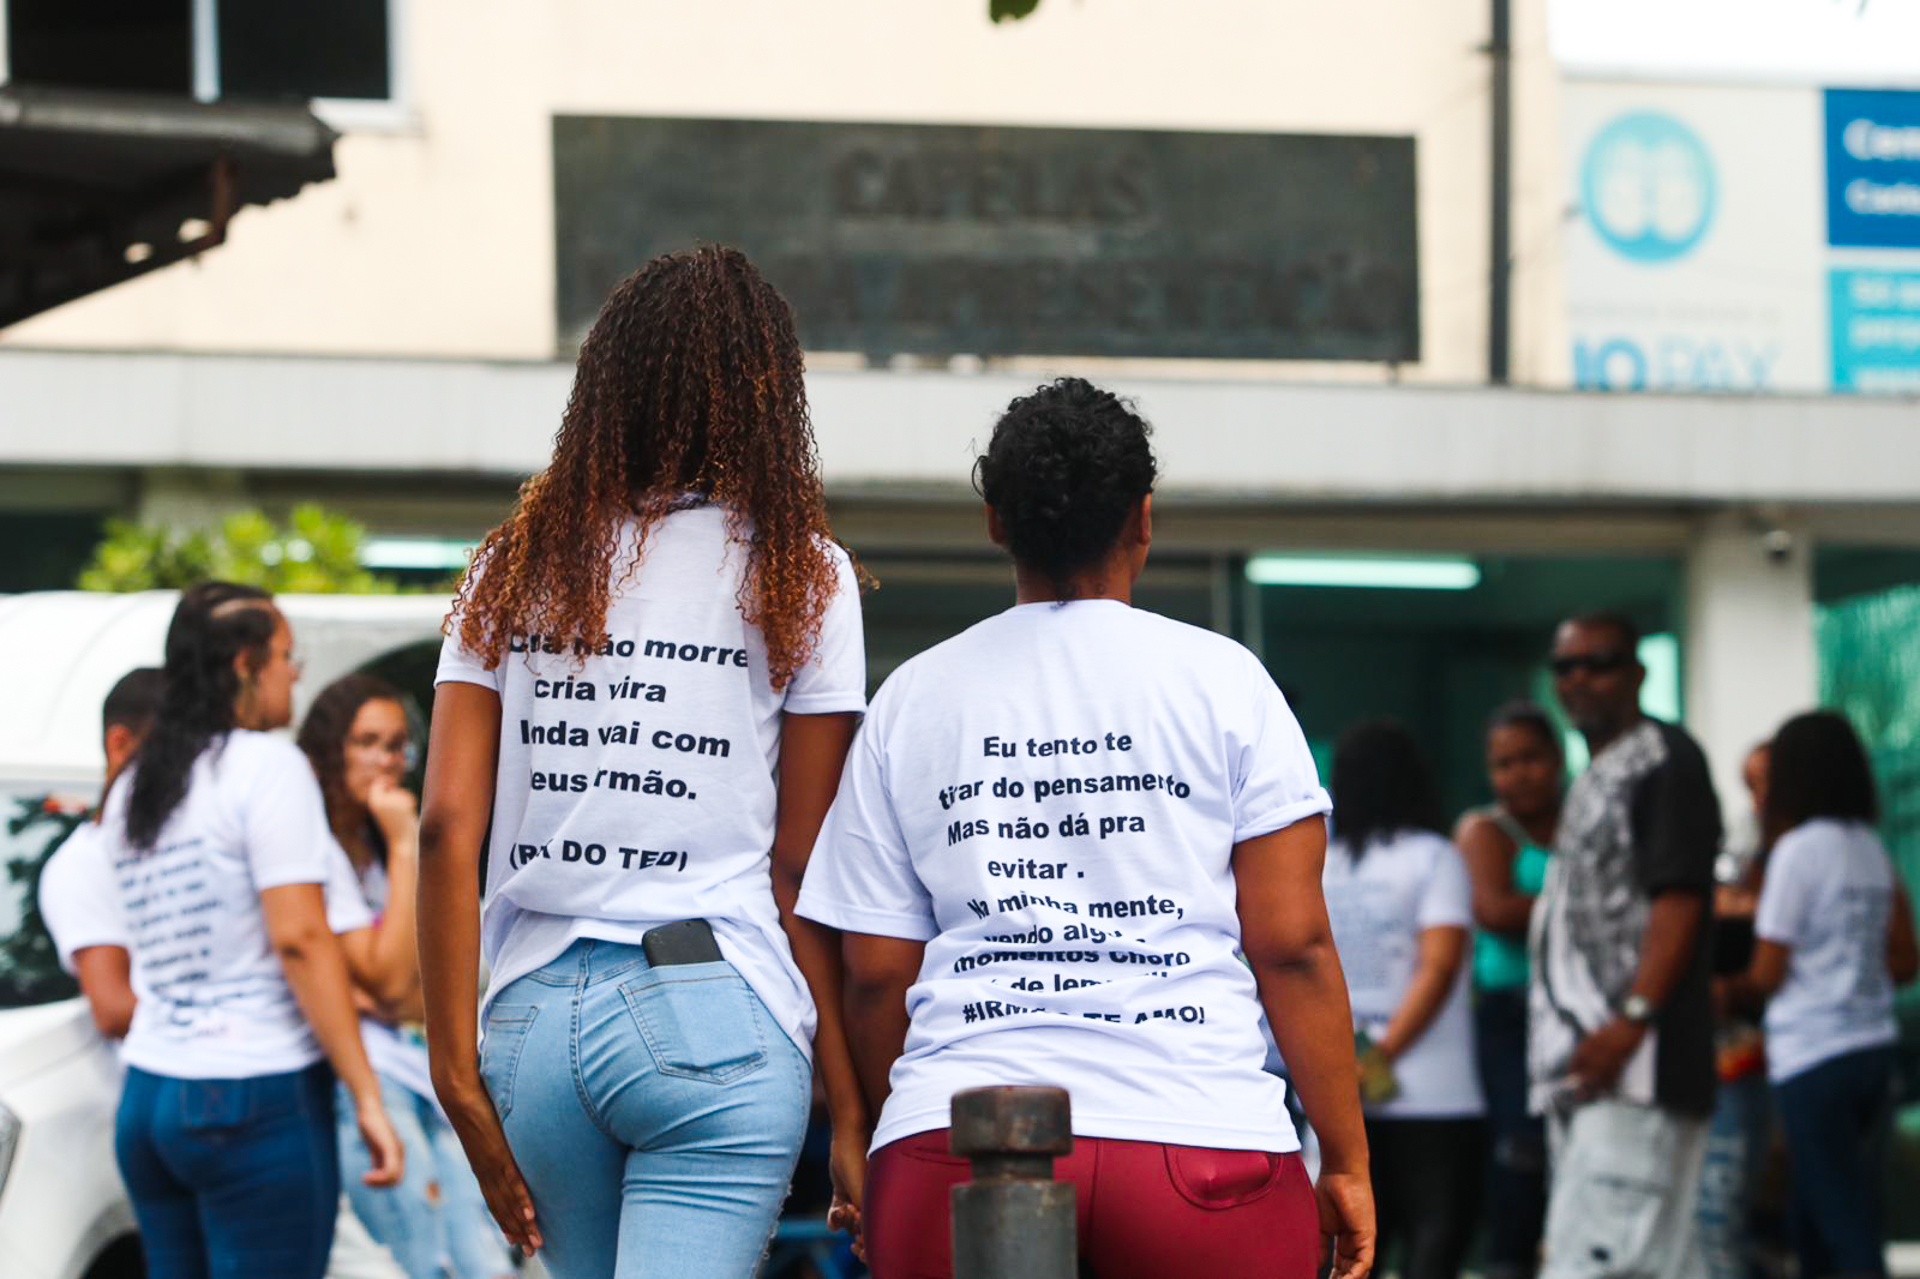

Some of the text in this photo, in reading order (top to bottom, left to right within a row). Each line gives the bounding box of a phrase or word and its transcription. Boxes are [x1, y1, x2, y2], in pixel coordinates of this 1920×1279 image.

[643, 639, 750, 668] morre
[534, 675, 667, 703] cria vira
[597, 720, 641, 746] vai
[651, 730, 731, 758] com
[983, 732, 1132, 758] Eu tento te
[530, 769, 697, 800] eus rmão.
[938, 780, 984, 811] tiar
[992, 776, 1025, 799] do
[947, 812, 1145, 847] Mas não dá pra
[561, 839, 607, 866] DO
[987, 858, 1068, 880] evitar
[997, 891, 1079, 914] minha
[1088, 894, 1183, 920] mente,
